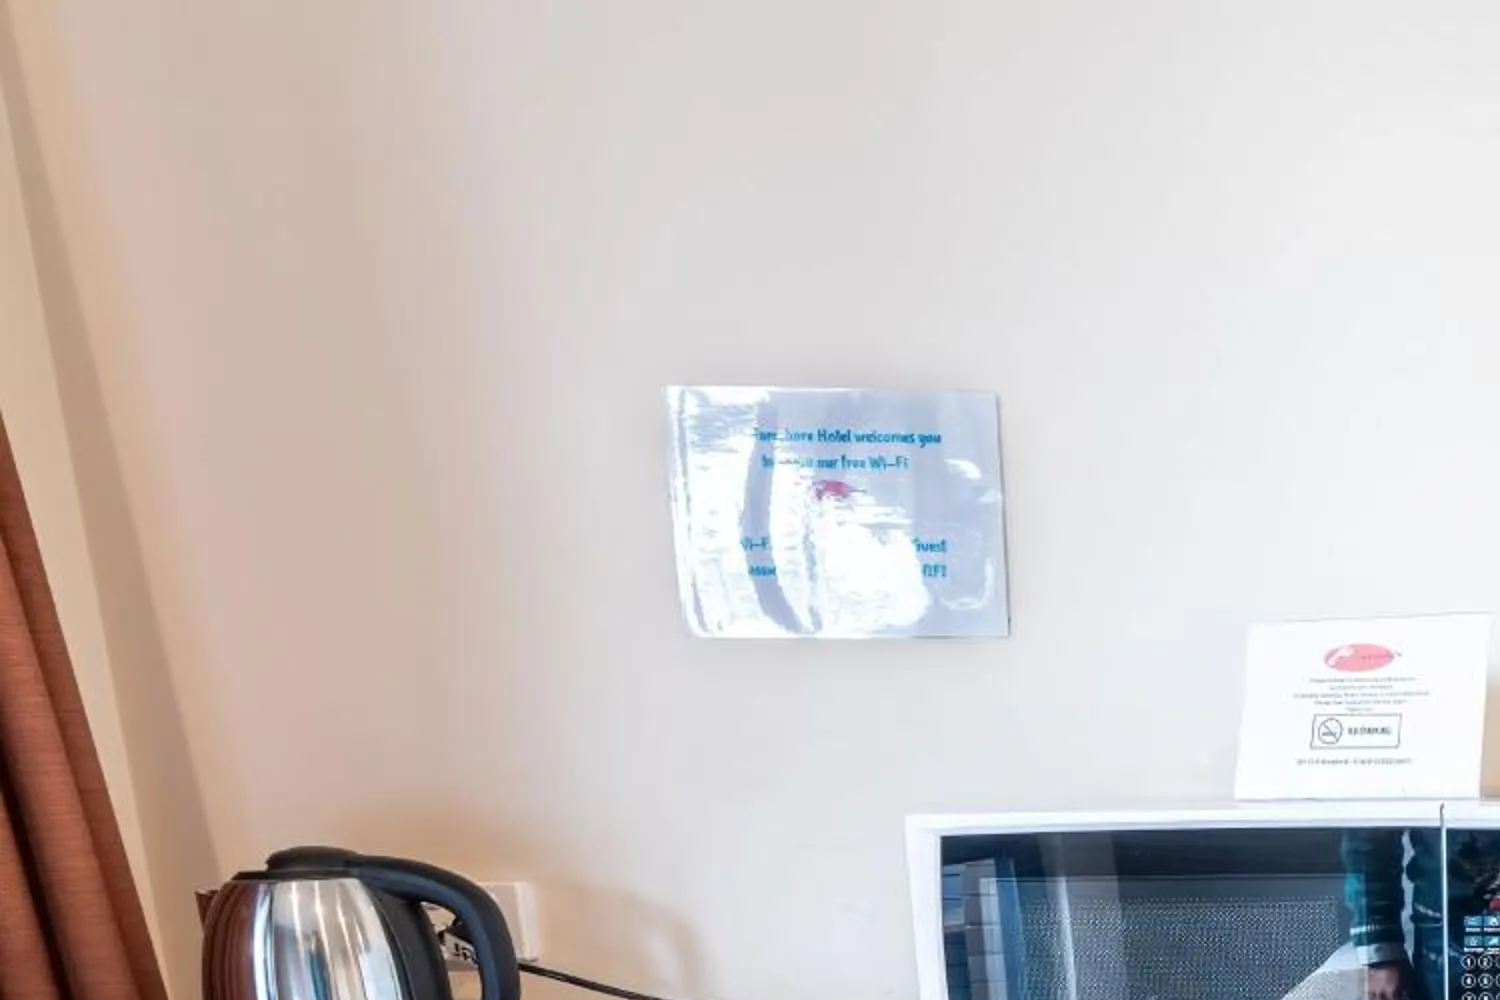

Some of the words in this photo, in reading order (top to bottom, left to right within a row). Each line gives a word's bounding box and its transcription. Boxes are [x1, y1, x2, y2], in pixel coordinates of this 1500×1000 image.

[816, 428, 852, 443] Hotel
[854, 430, 916, 444] welcomes
[918, 432, 942, 448] you
